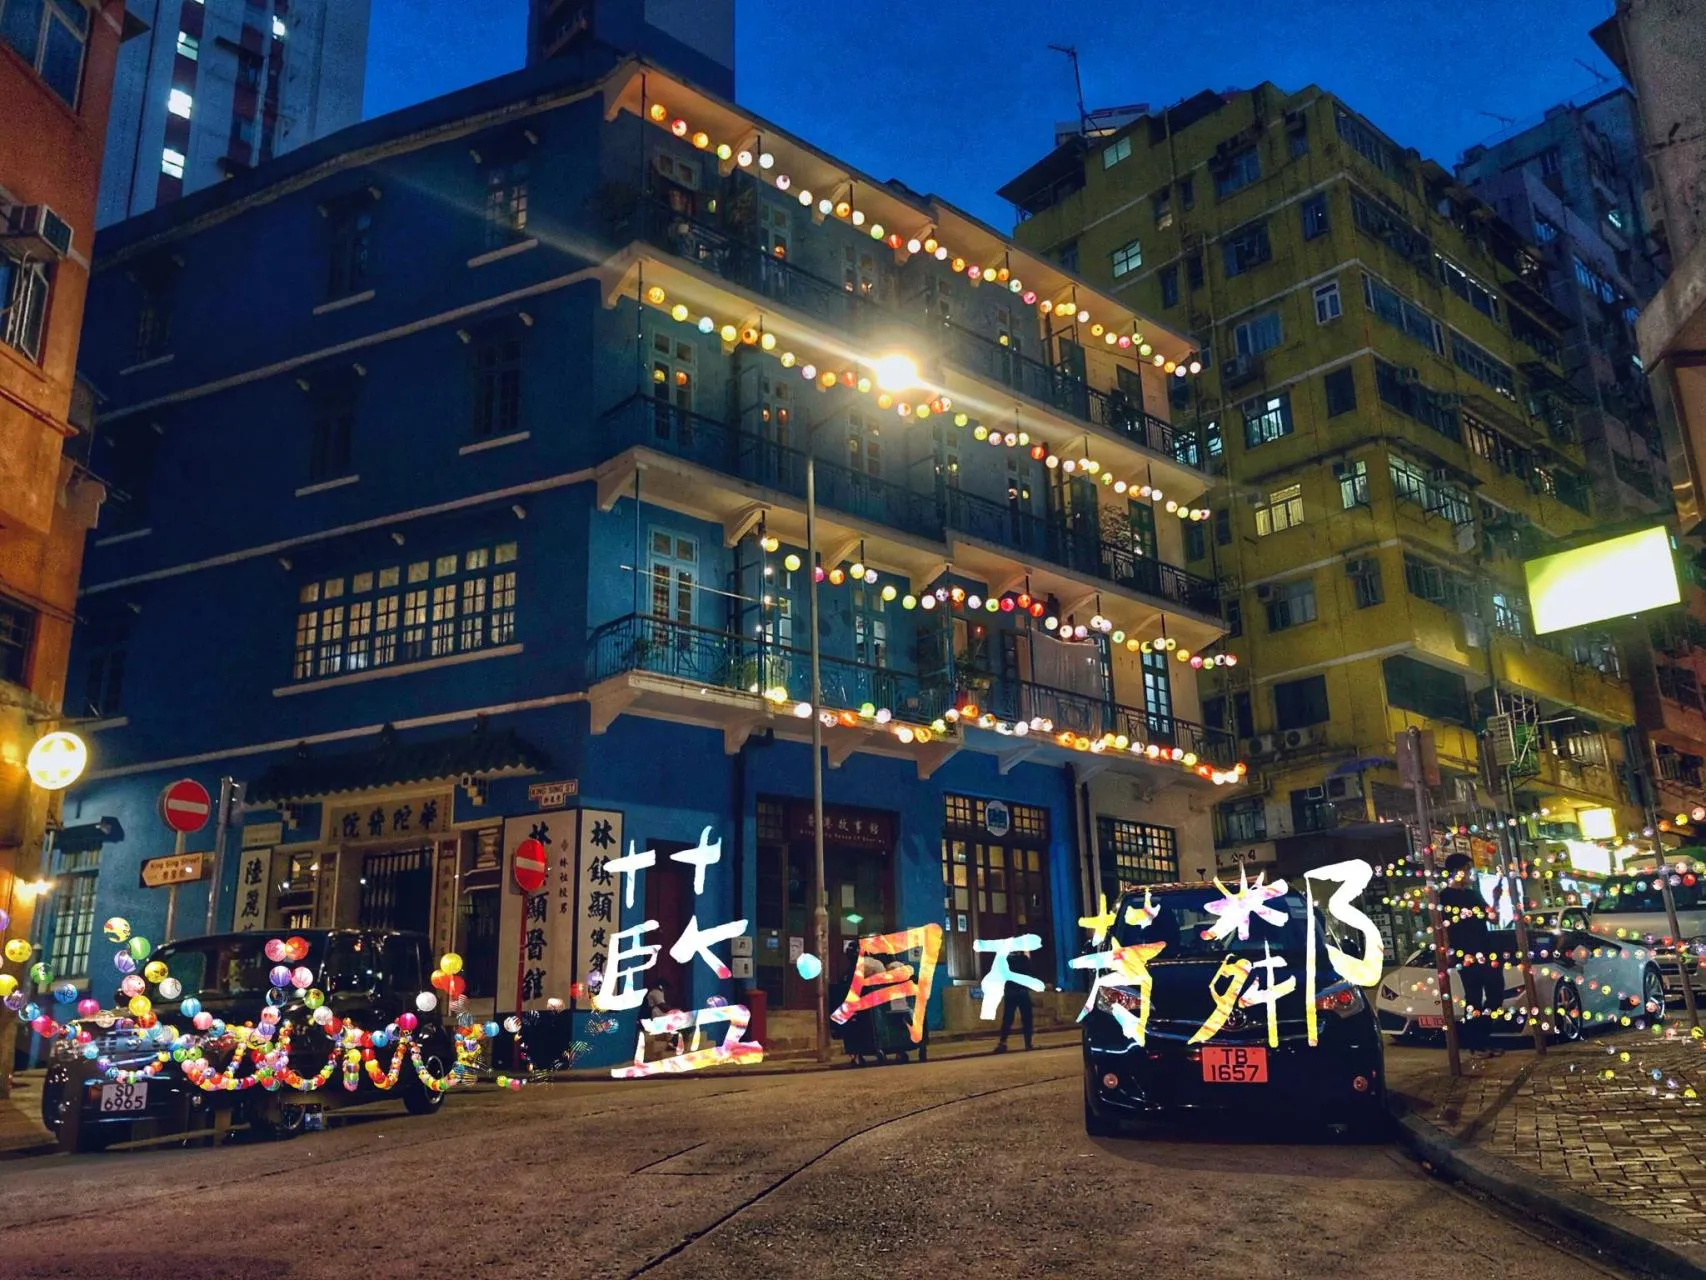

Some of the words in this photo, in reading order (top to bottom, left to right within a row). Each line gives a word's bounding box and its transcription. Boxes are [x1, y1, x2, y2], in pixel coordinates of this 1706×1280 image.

[1221, 1049, 1248, 1064] TB
[1211, 1065, 1259, 1081] 1657
[115, 1083, 134, 1097] SD
[104, 1096, 143, 1111] 6965
